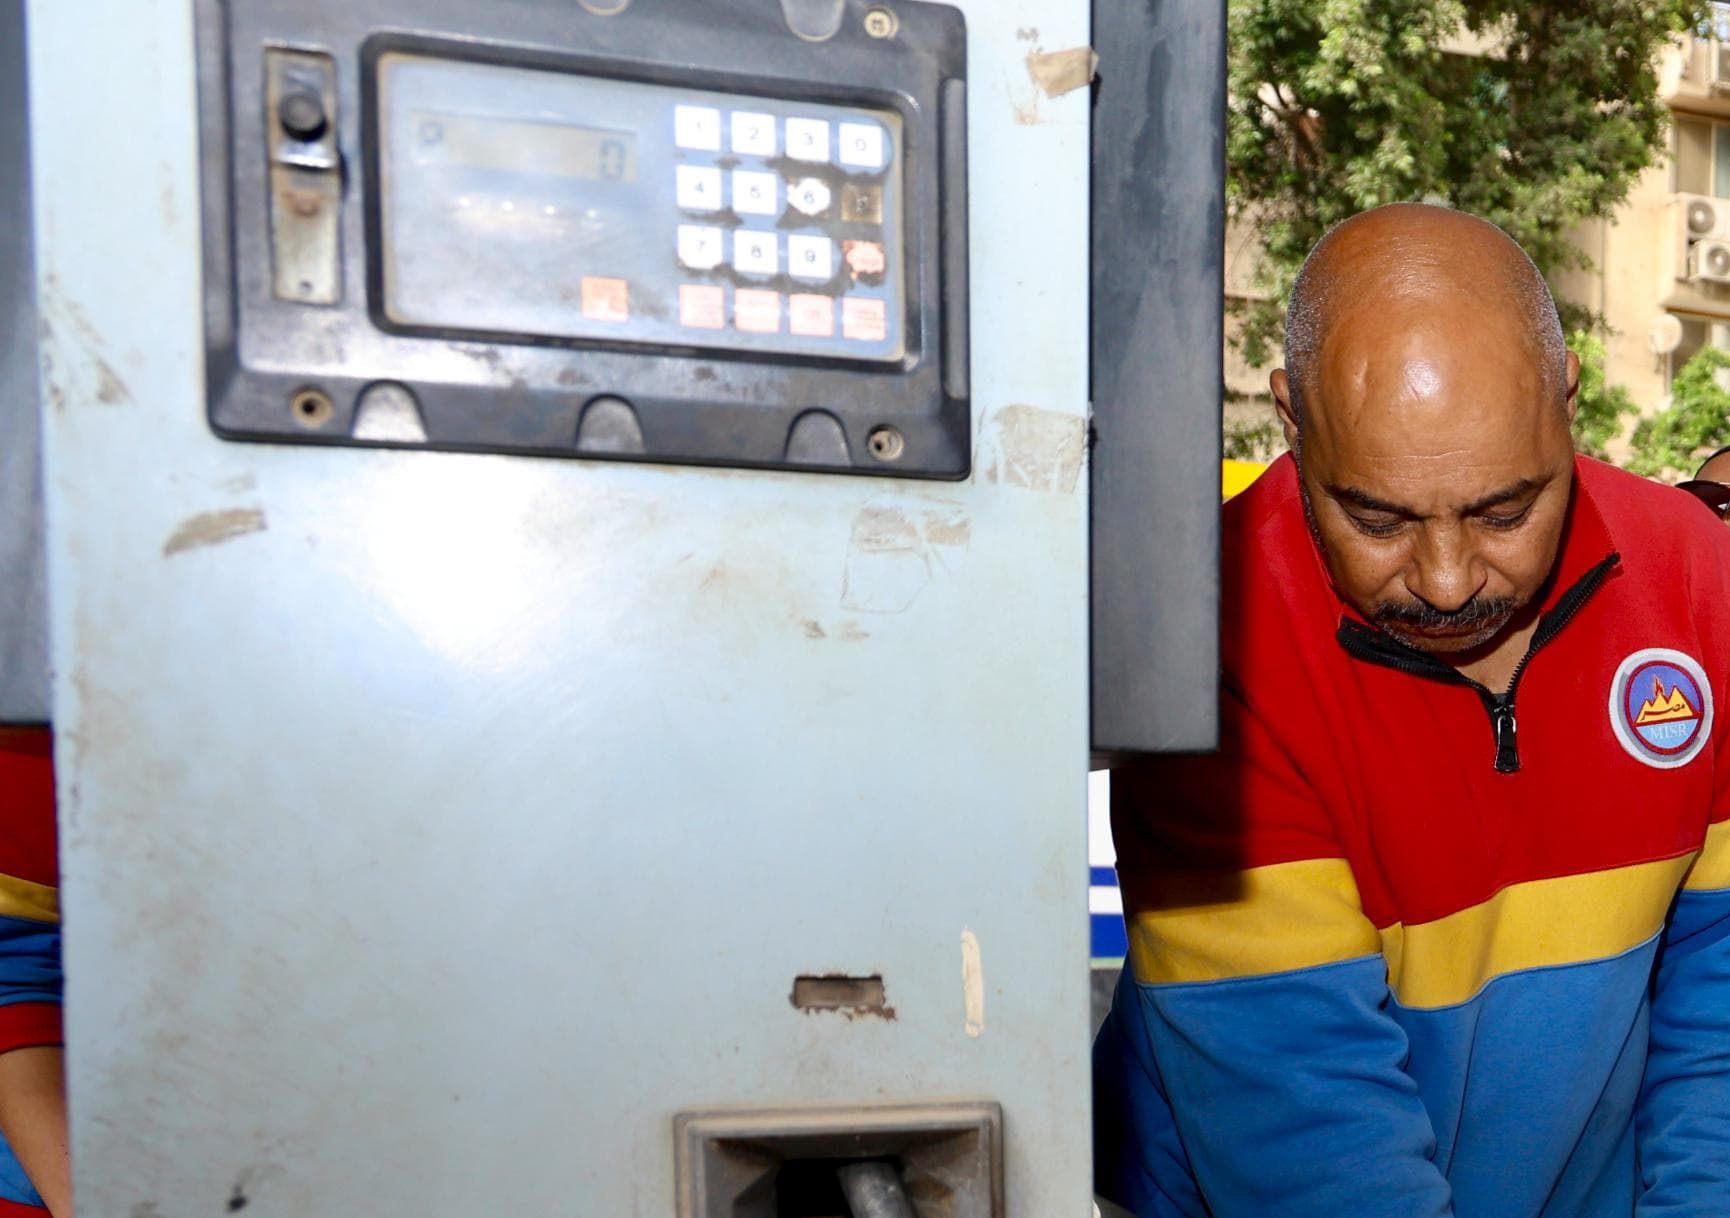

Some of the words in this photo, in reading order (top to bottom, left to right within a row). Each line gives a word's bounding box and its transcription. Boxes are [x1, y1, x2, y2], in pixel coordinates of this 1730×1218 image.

[749, 127, 760, 141] 2
[803, 133, 814, 146] 3
[694, 181, 705, 194] 4
[750, 185, 761, 199] 5
[803, 190, 815, 204] 6
[751, 244, 762, 258] 8
[805, 248, 817, 263] 9
[1640, 703, 1685, 721] مصر
[1650, 725, 1687, 739] MISR
